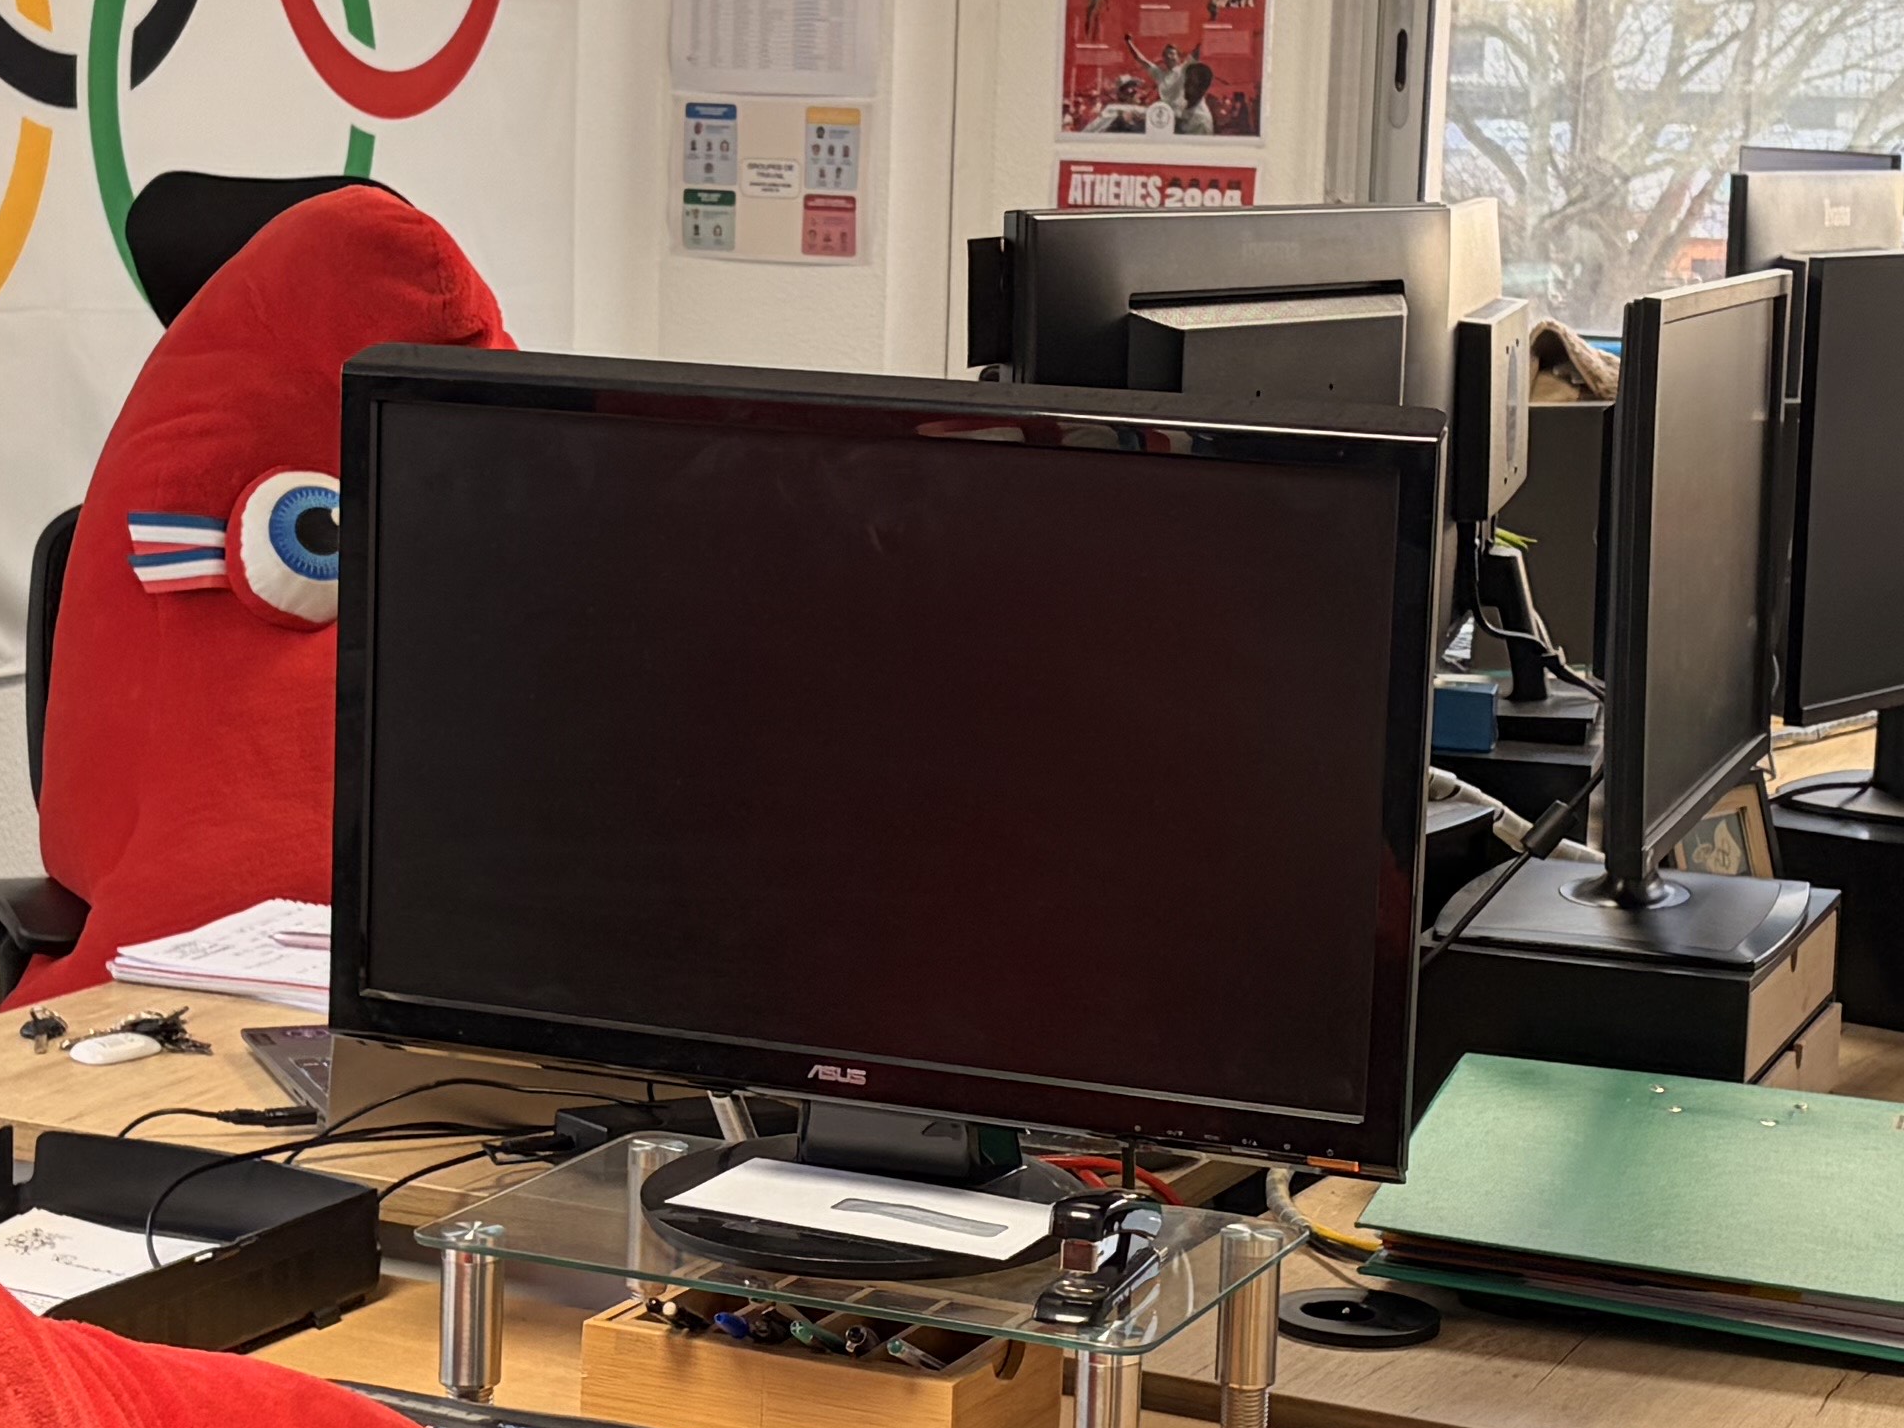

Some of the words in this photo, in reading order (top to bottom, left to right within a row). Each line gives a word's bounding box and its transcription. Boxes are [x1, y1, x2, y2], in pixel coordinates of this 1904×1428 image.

[1068, 173, 1163, 208] ATHÈNES
[1164, 186, 1243, 208] 2004
[807, 1064, 867, 1086] ASUS
